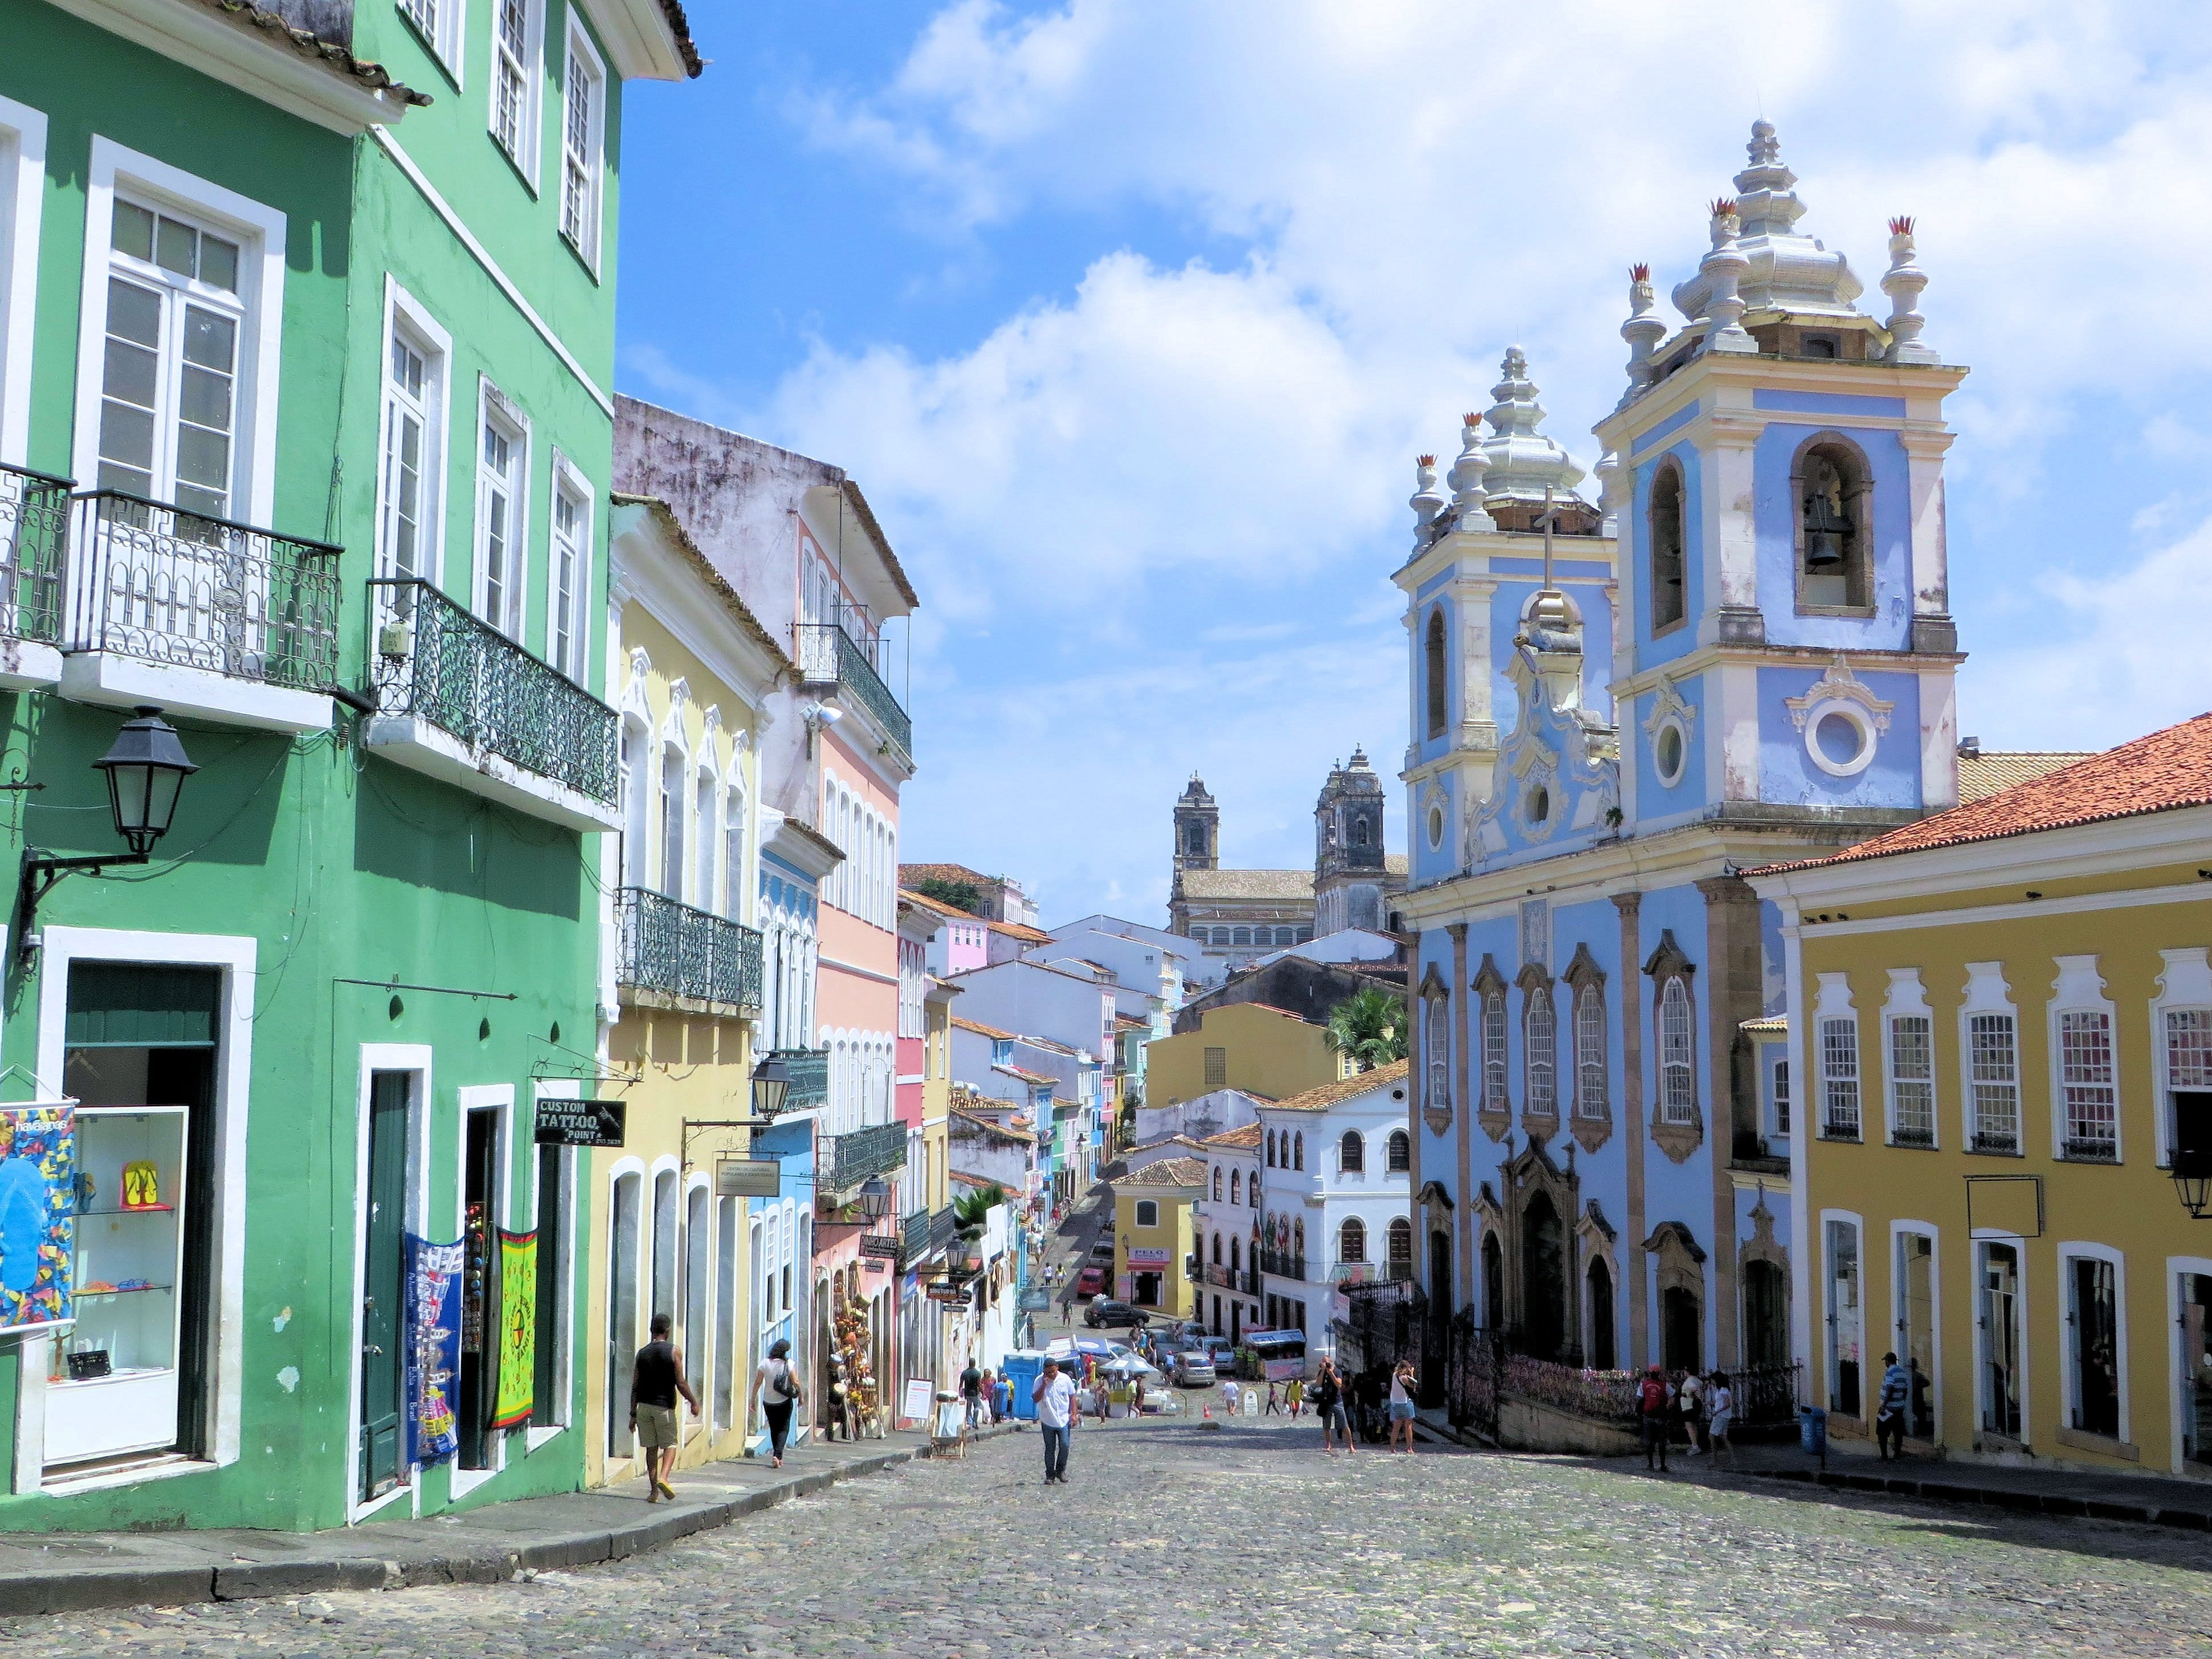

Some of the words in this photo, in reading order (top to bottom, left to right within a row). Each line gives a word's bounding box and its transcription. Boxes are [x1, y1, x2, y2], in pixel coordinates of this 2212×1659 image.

[540, 1101, 586, 1113] CUSTOM
[15, 1119, 67, 1132] havaianas
[539, 1114, 597, 1129] TATTOO
[568, 1130, 596, 1139] POINT
[879, 1238, 897, 1249] ARTES
[409, 1402, 418, 1422] Brasil
